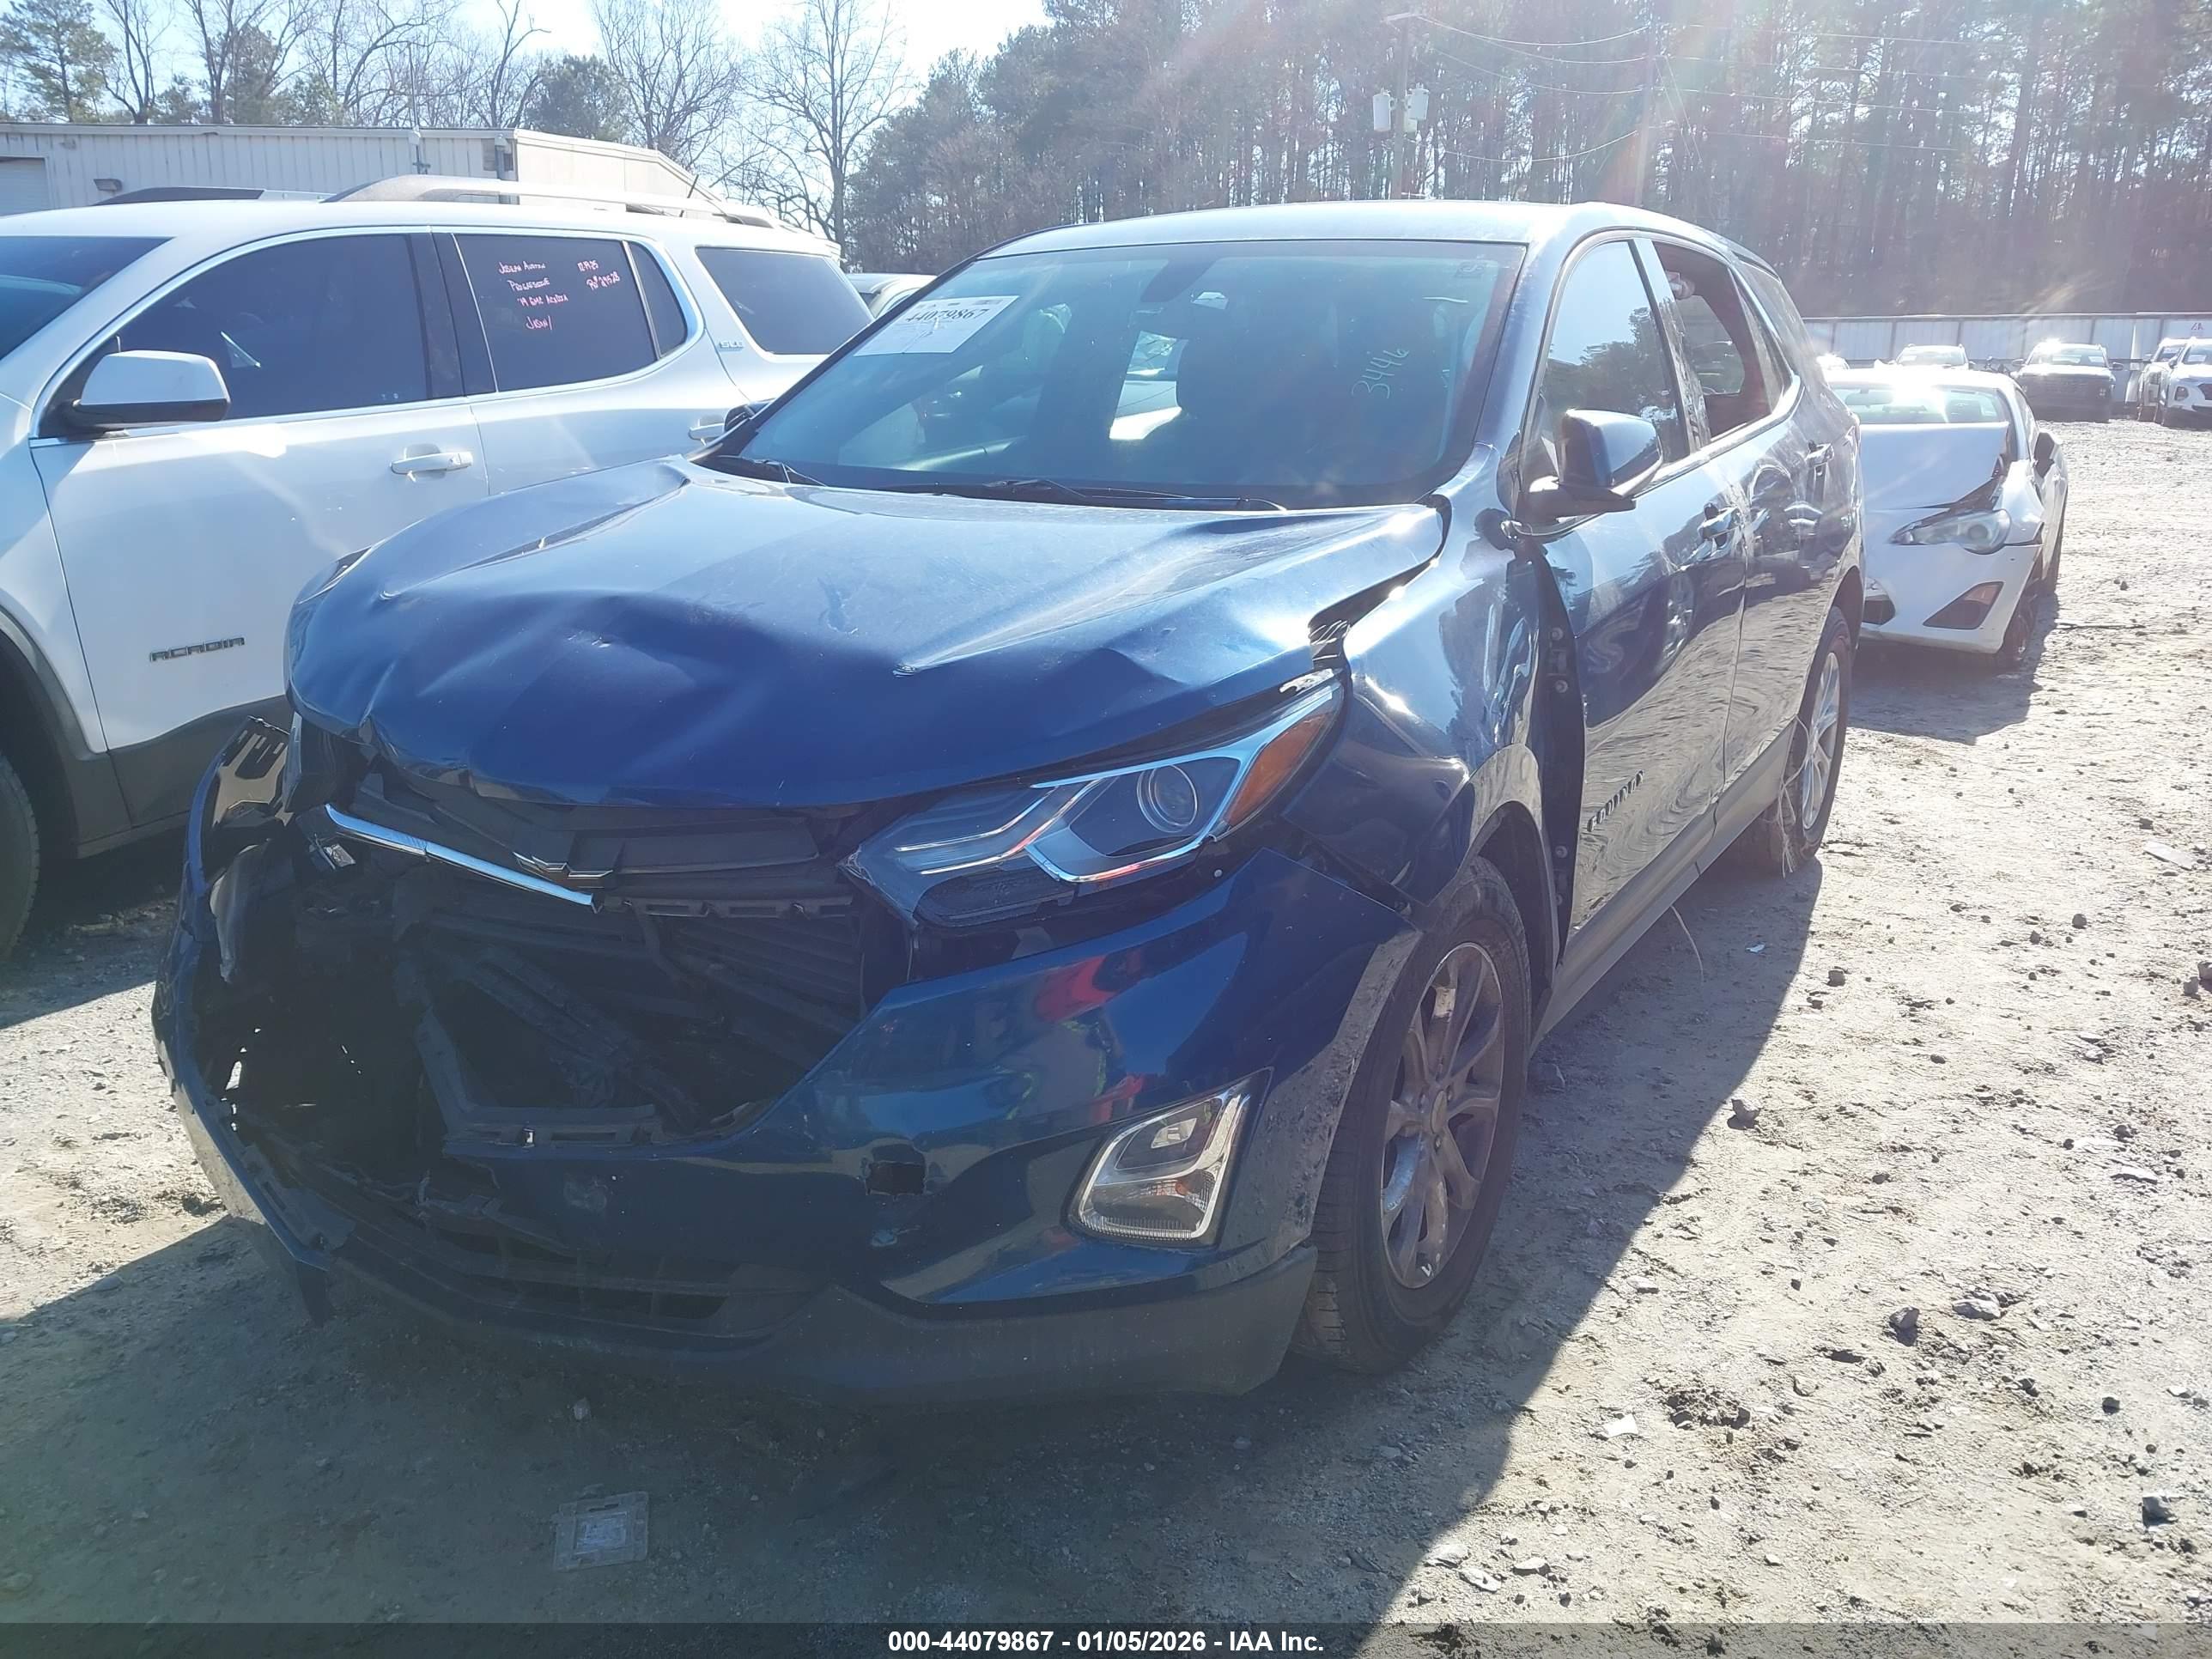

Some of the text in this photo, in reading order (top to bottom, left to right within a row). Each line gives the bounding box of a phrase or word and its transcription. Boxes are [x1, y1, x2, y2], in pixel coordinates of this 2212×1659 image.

[905, 308, 991, 323] 44079867
[1351, 347, 1410, 399] 3446
[149, 636, 246, 662] ACADIA
